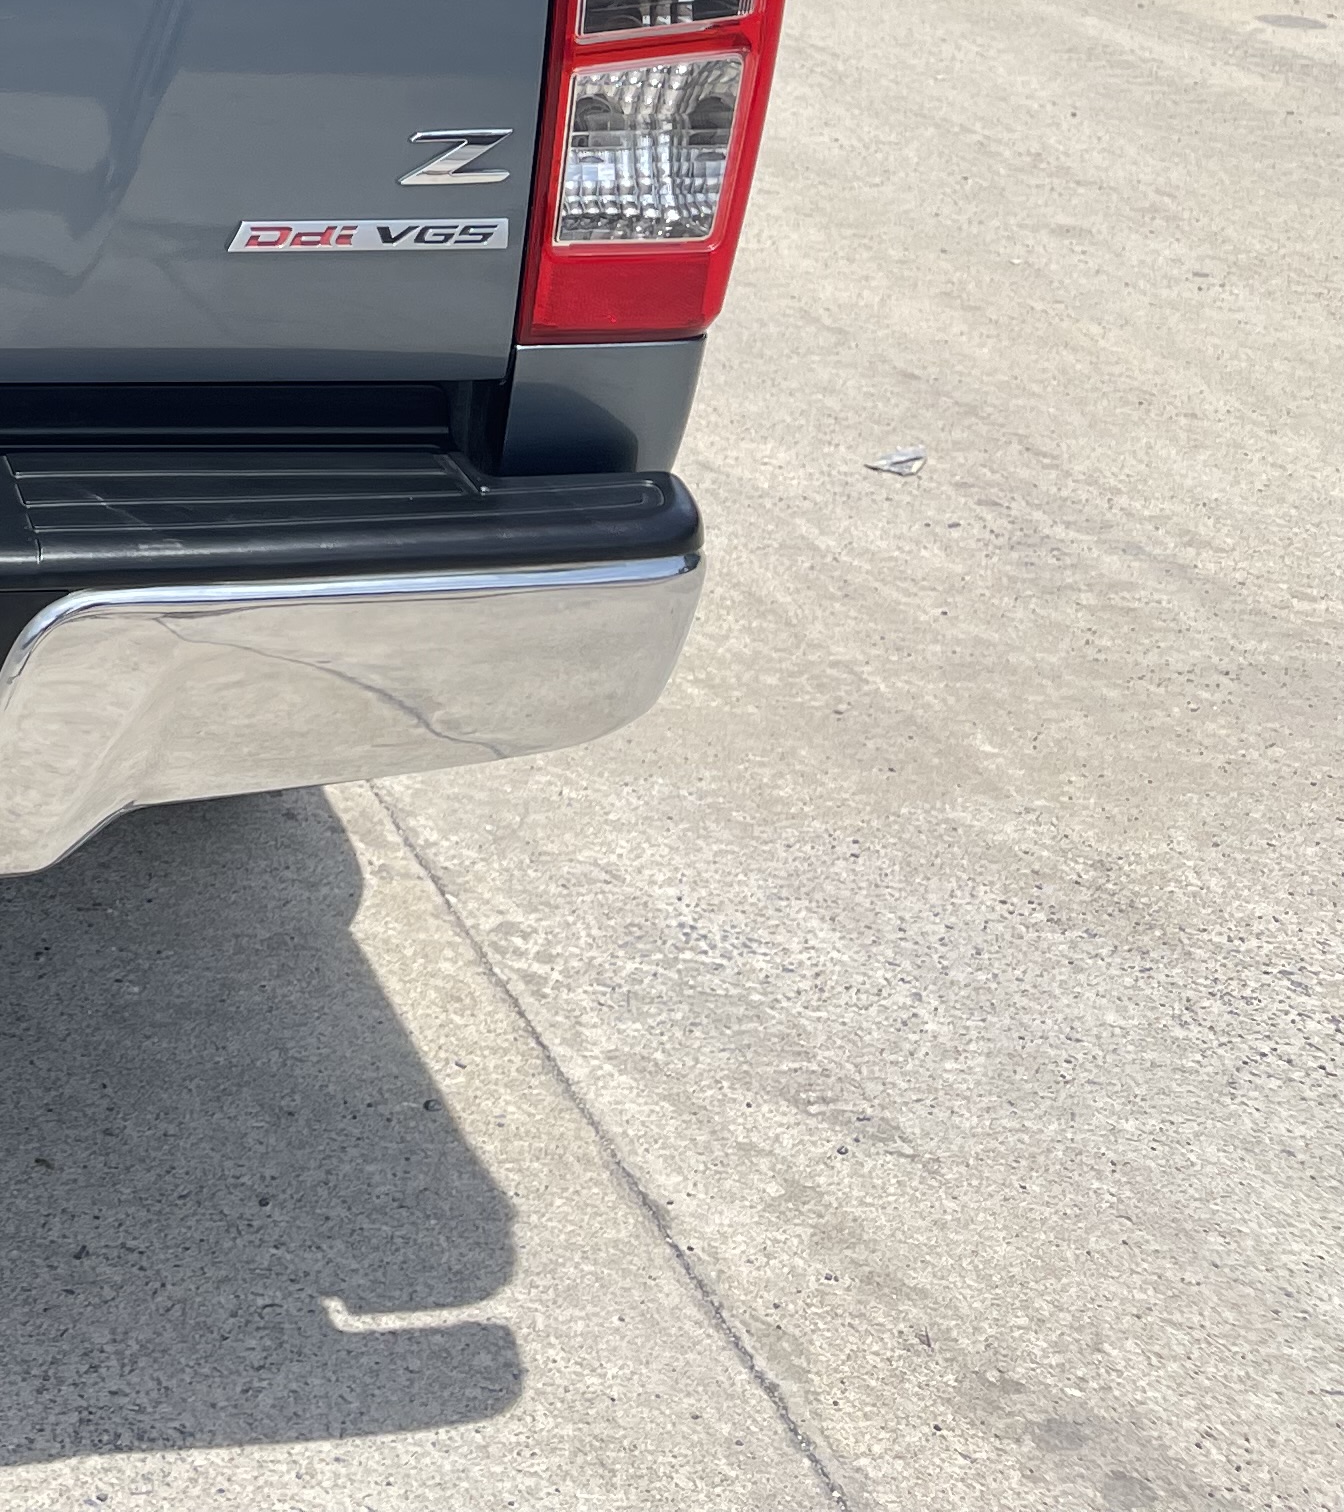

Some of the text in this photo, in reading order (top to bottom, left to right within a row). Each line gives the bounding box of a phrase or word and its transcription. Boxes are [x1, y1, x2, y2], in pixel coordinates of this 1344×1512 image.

[396, 128, 513, 186] Z
[244, 224, 499, 248] Ddi VGS
